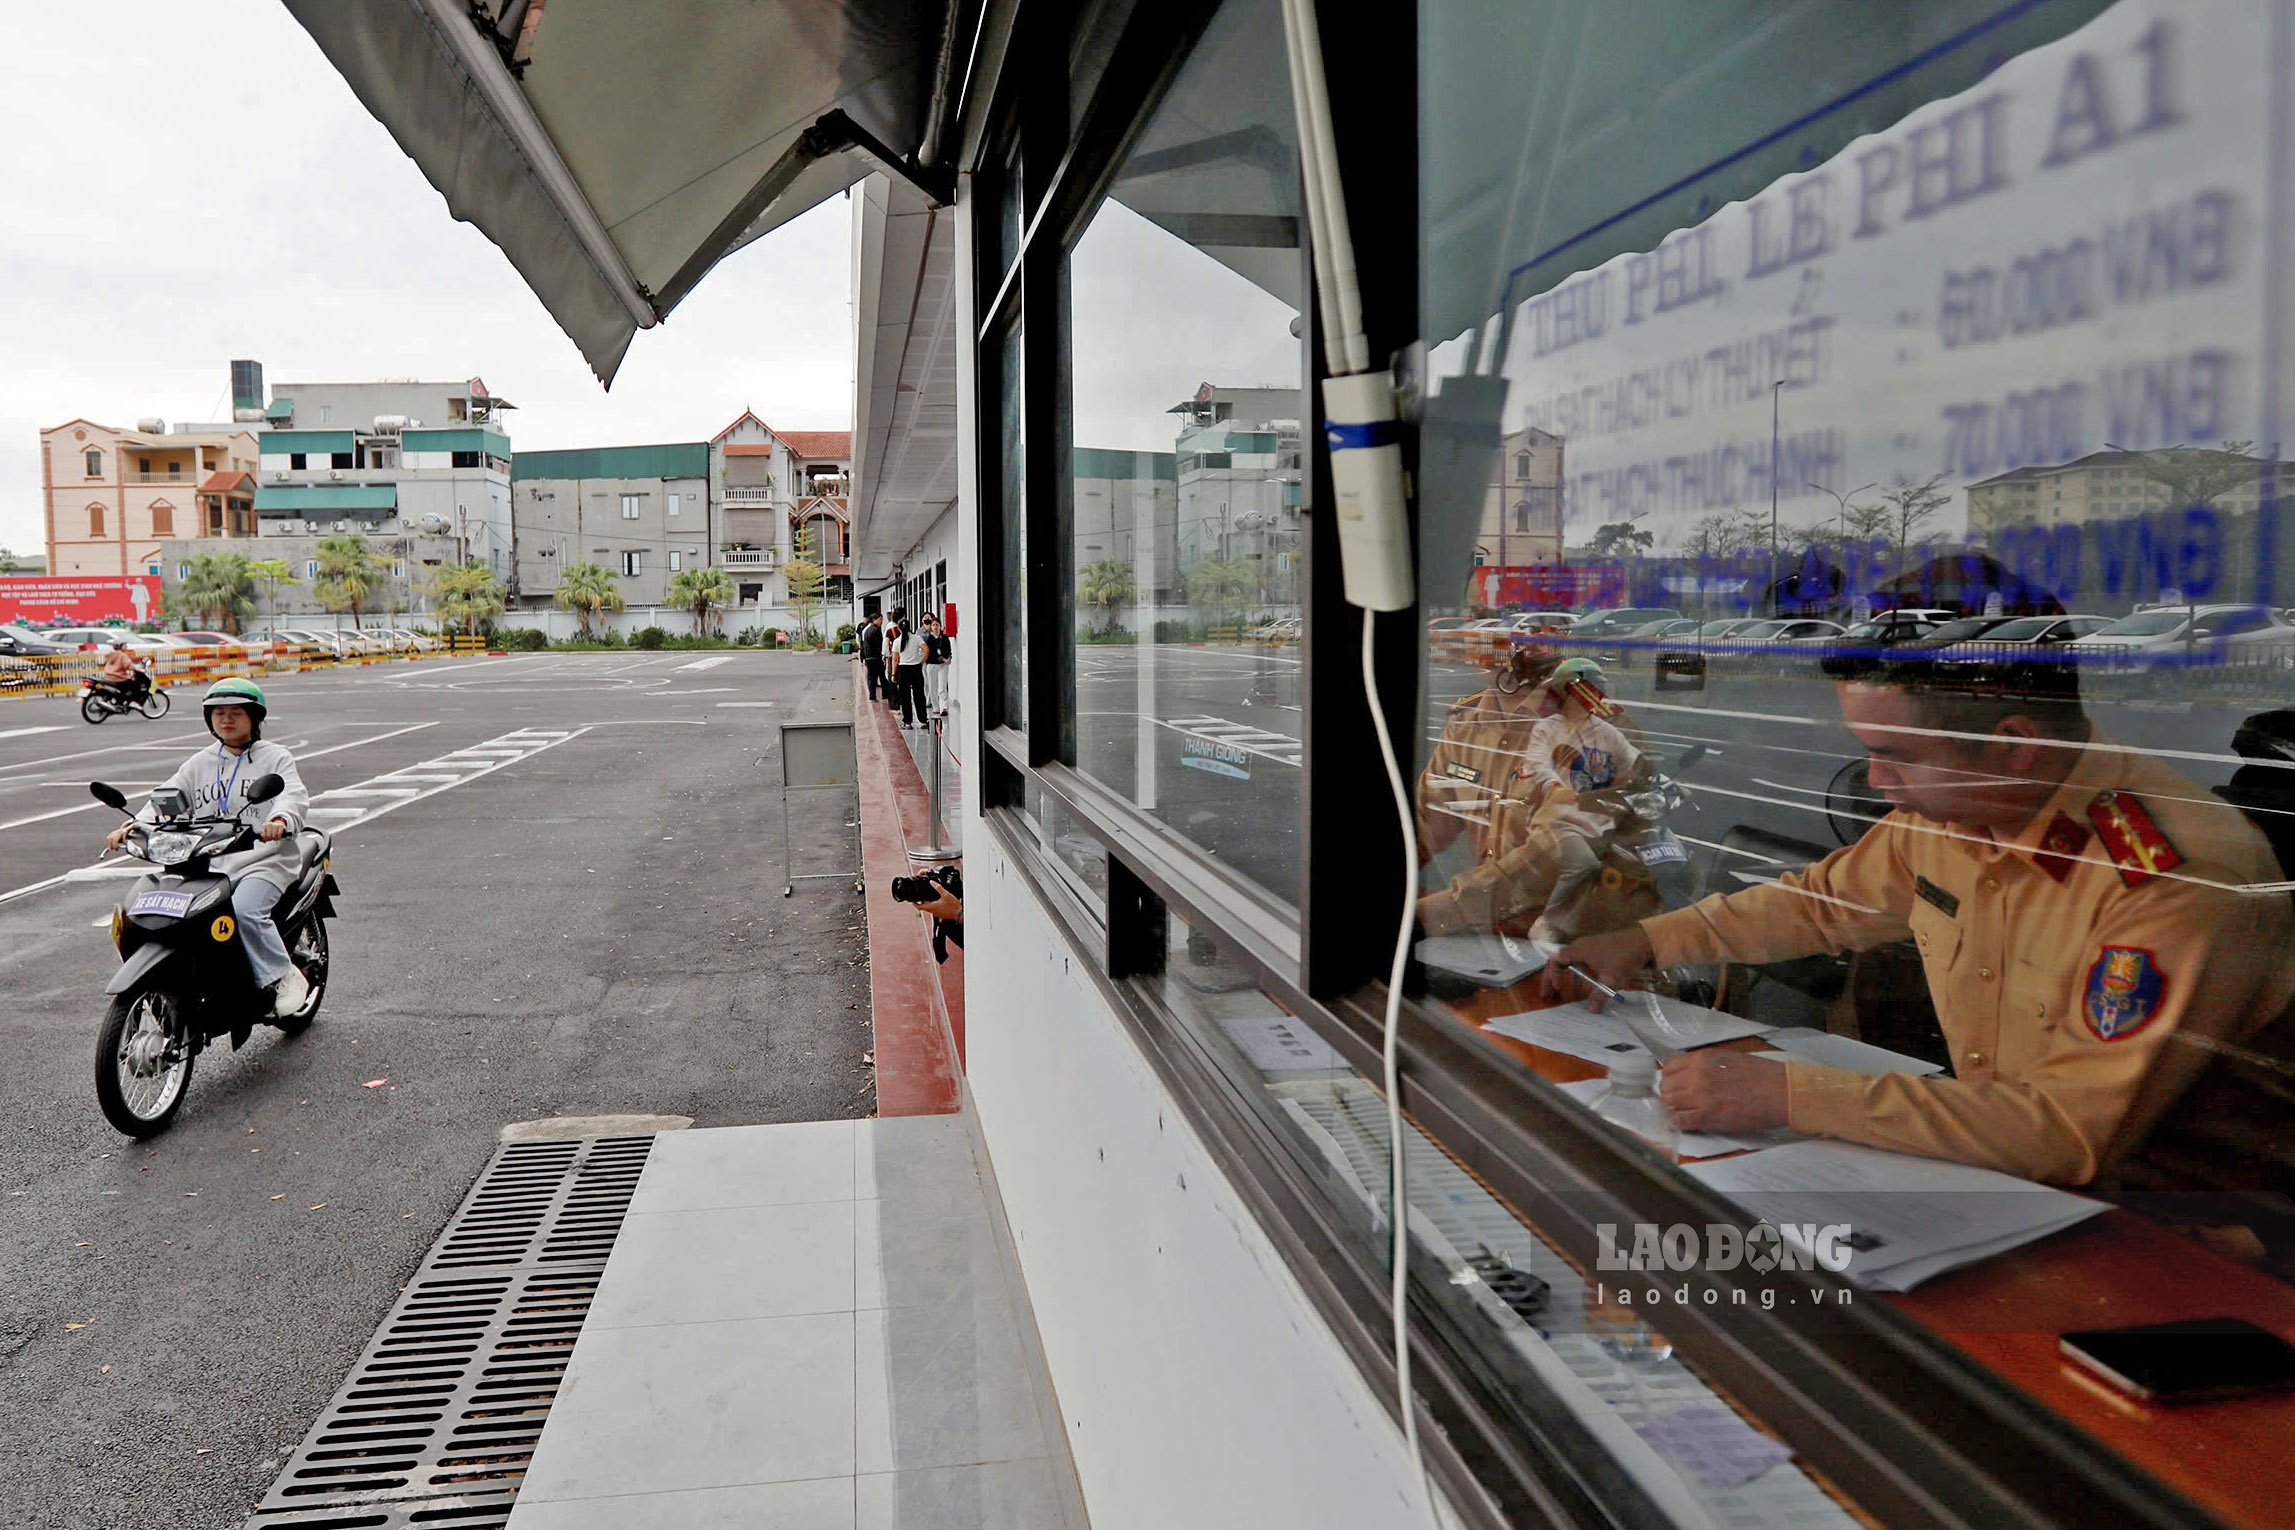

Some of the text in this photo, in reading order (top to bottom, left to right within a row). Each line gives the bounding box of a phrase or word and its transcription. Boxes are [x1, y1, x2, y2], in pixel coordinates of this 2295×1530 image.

[1528, 270, 1610, 359] THU
[2039, 18, 2189, 170] A1
[145, 894, 164, 908] SÁT
[161, 896, 187, 911] HẠCH
[219, 920, 229, 935] 4
